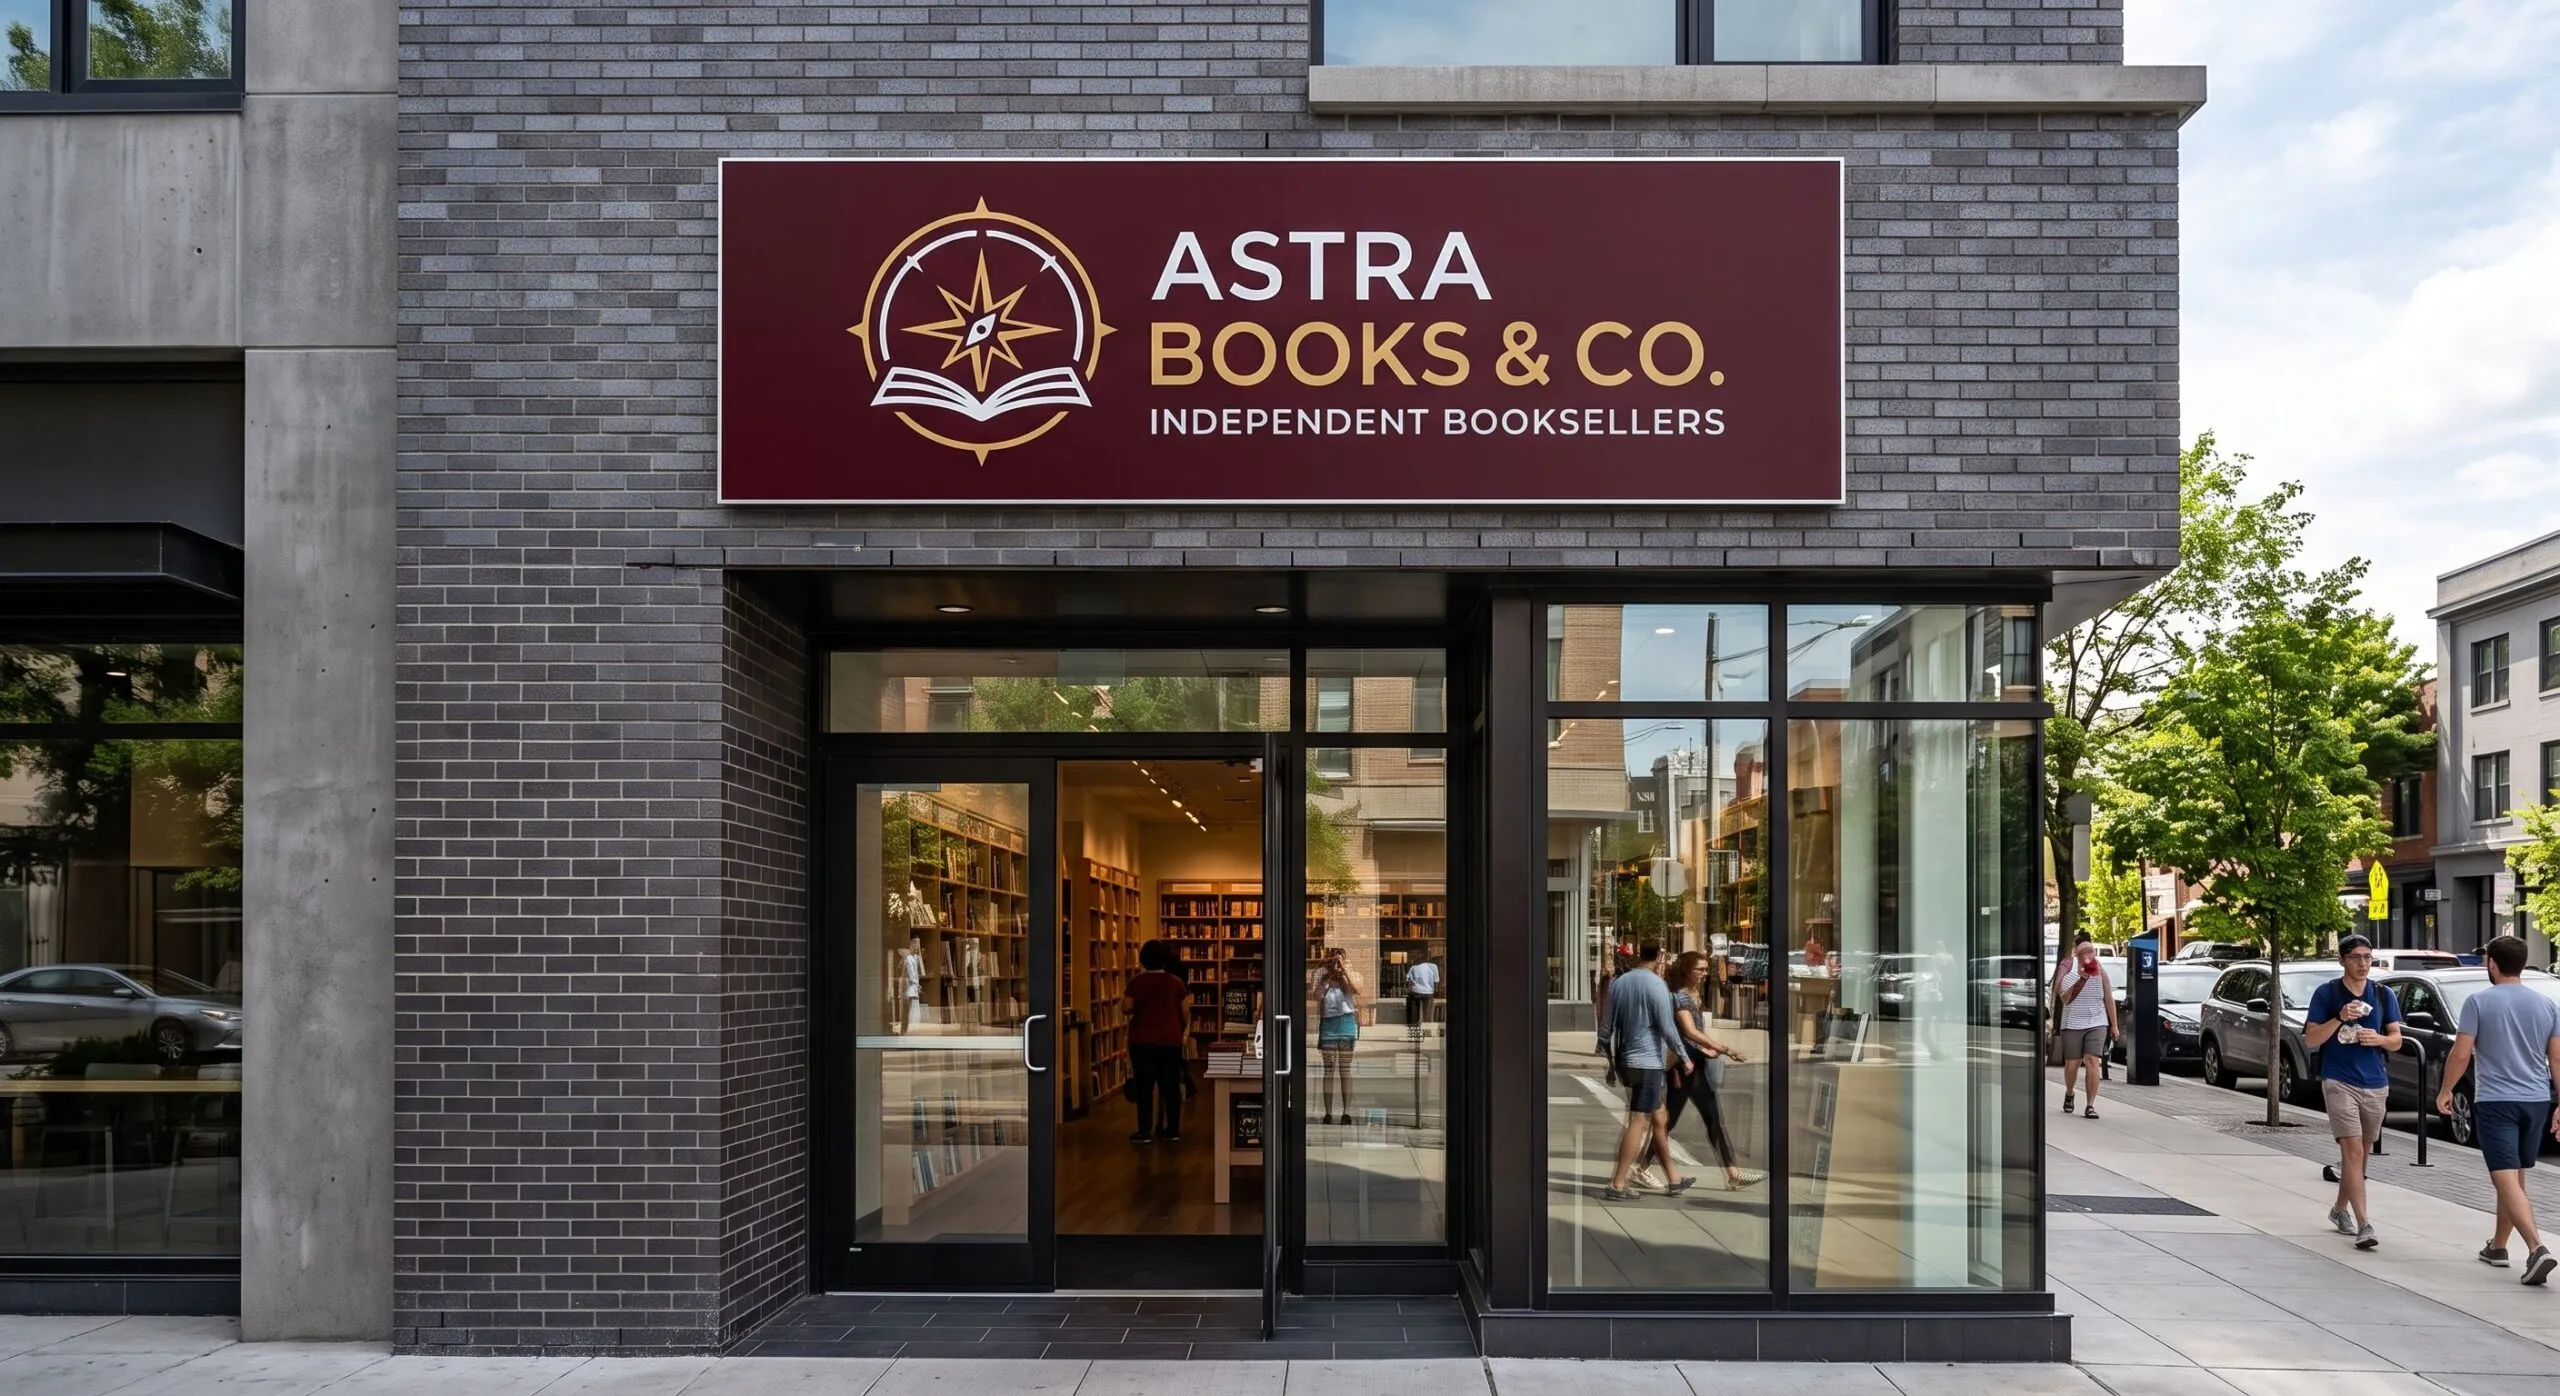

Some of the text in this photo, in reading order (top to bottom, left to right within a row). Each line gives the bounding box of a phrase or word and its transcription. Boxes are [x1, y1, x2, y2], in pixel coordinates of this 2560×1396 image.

[1151, 230, 1493, 301] ASTRA
[1151, 320, 1725, 387] BOOKS & CO.
[1151, 408, 1725, 435] INDEPENDENT BOOKSELLERS
